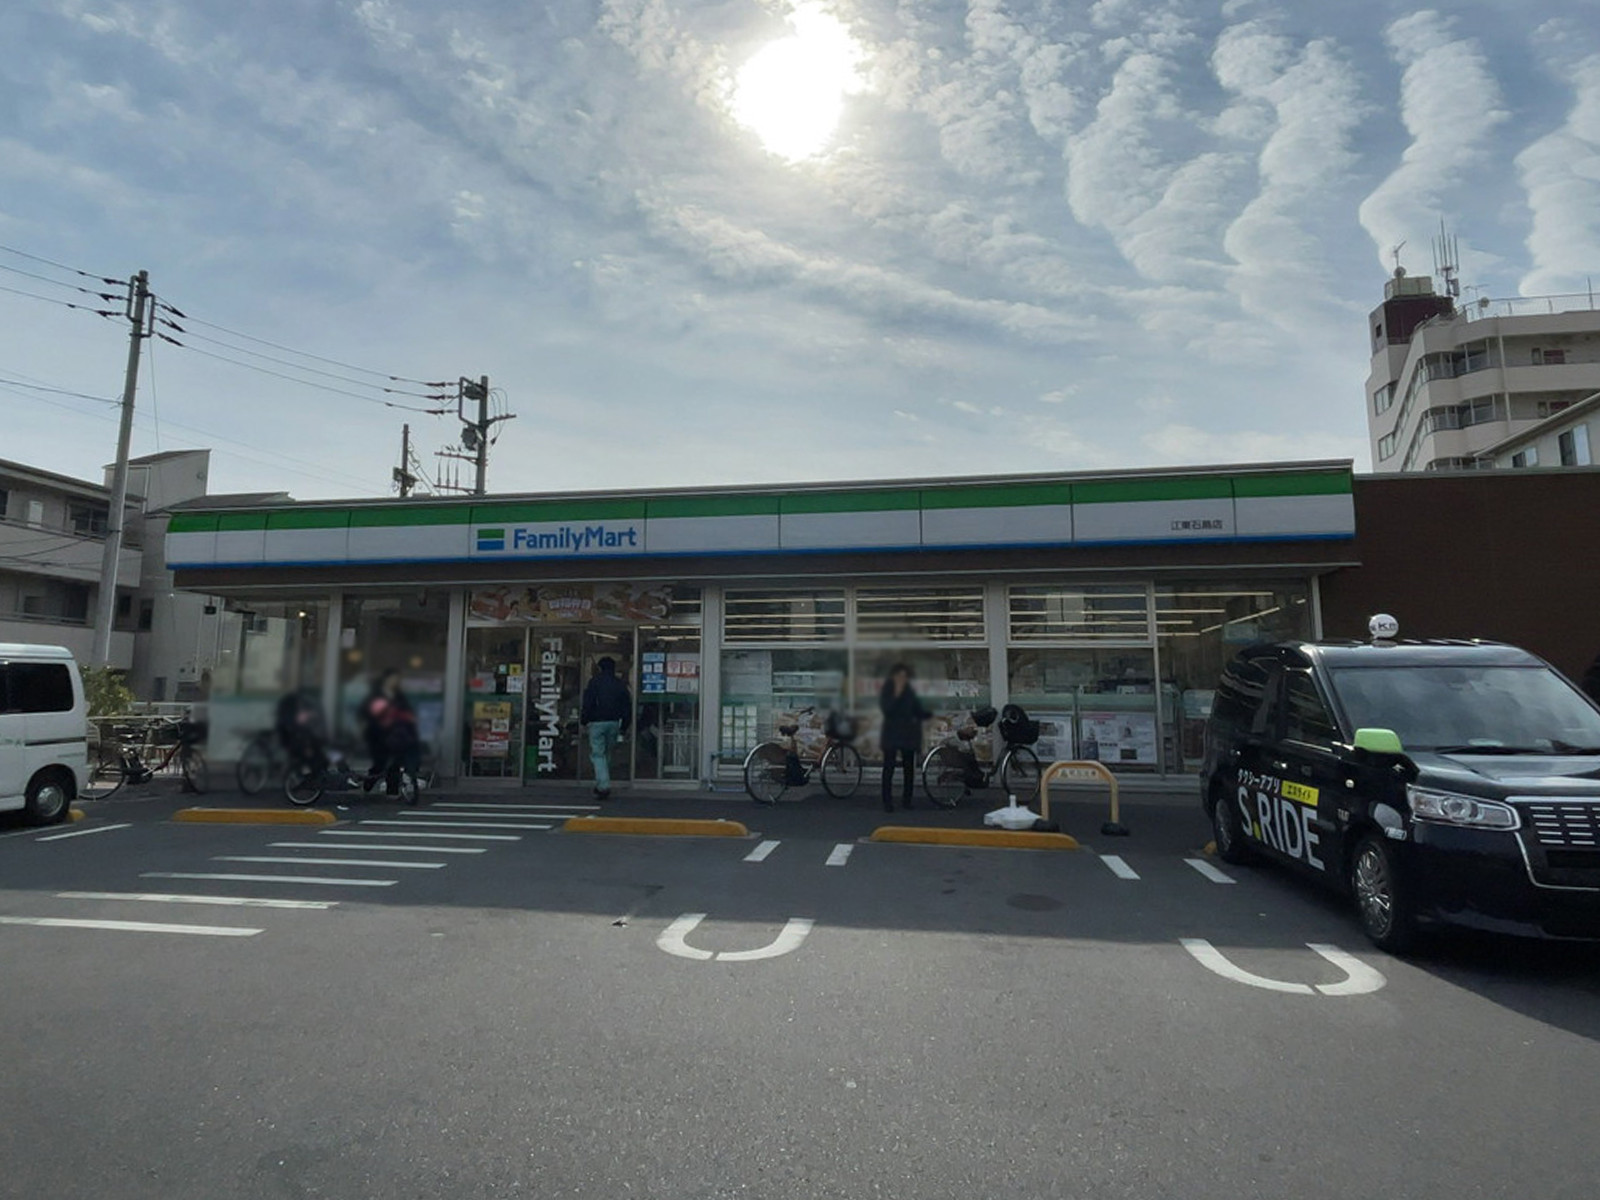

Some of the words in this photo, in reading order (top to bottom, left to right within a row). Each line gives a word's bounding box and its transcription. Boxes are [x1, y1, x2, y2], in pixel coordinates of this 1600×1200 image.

[514, 526, 637, 552] FamilyMart
[534, 637, 563, 773] FamilyMart
[1237, 768, 1281, 794] タクシーアプリ
[1237, 785, 1326, 872] S.RIDE
